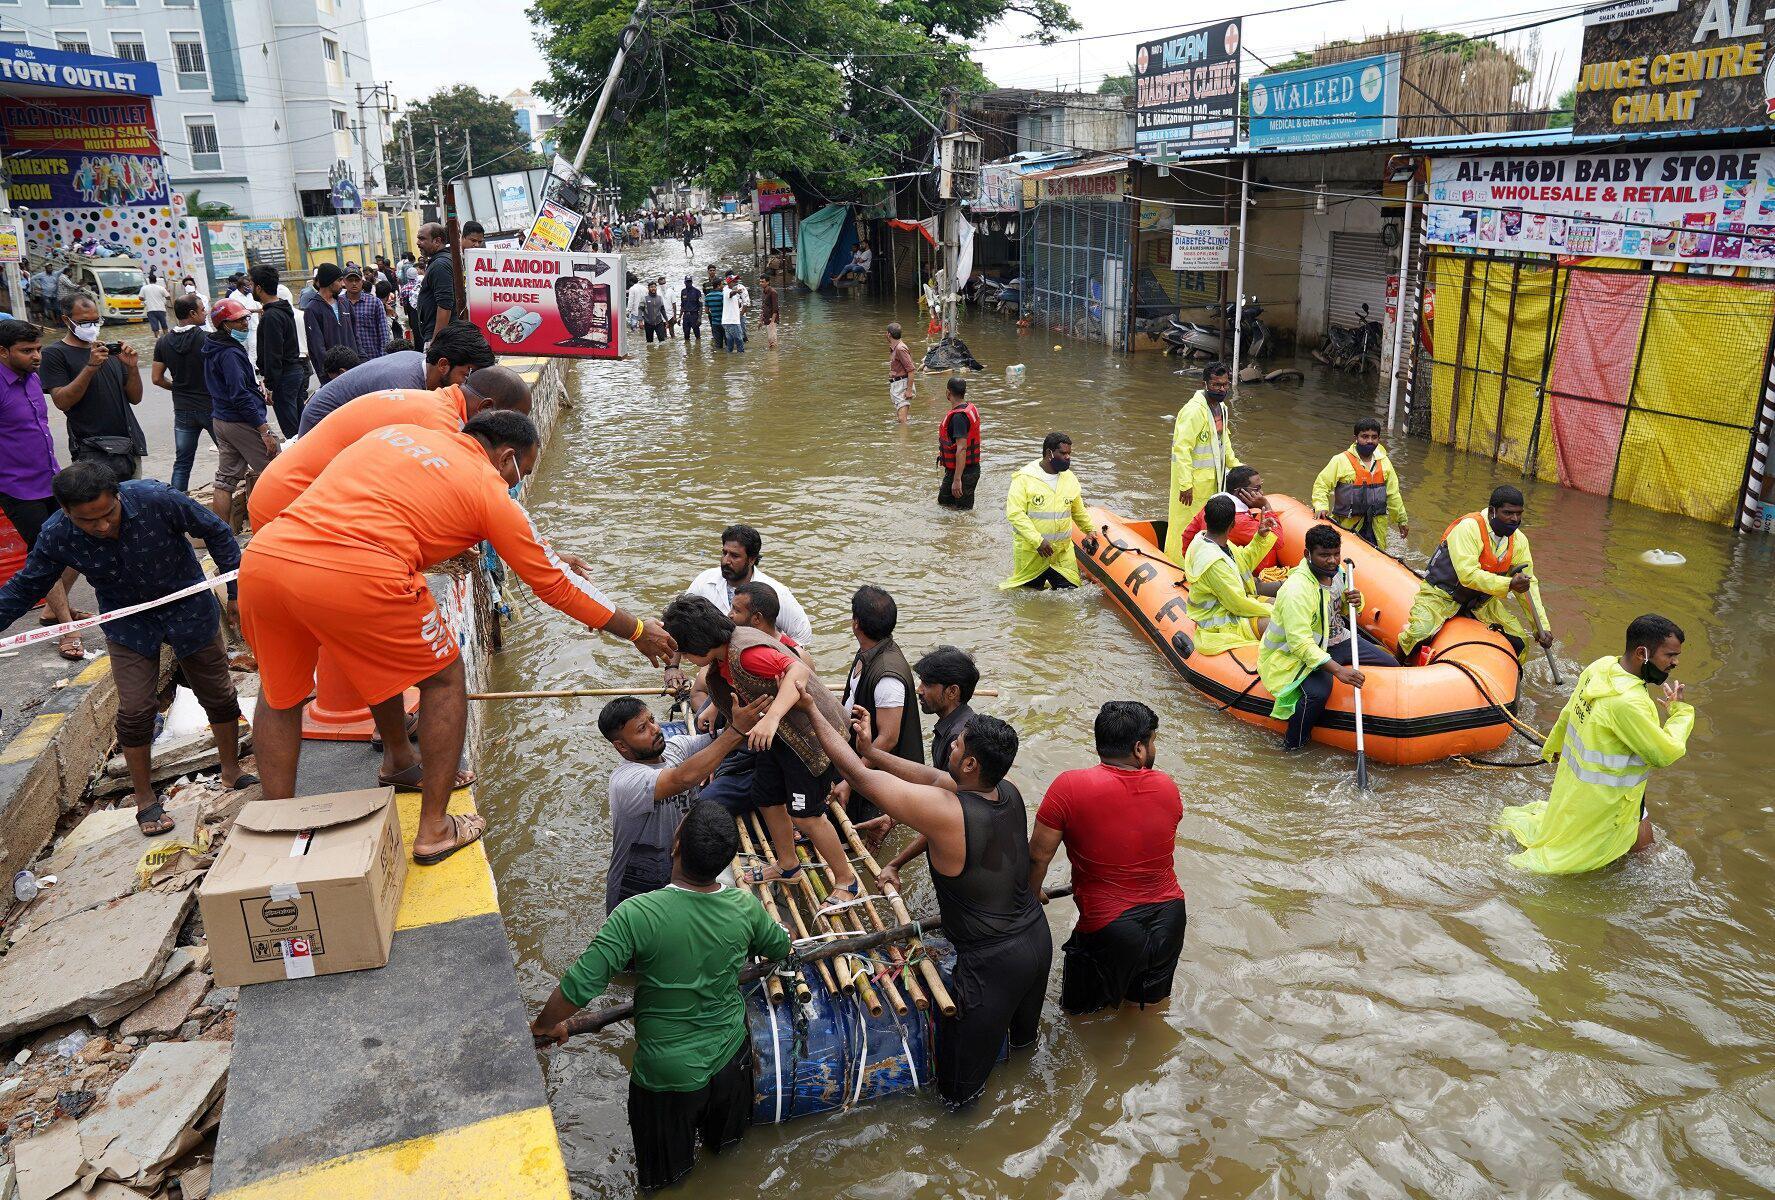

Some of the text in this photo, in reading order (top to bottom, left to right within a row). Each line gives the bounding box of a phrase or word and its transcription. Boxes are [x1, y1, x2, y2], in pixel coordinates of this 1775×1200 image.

[1599, 6, 1654, 22] SHAIK FAHAD AMODI
[1162, 31, 1209, 69] NIZAM
[1576, 41, 1767, 93] JUICE CENTRE
[62, 65, 137, 91] OUTLET
[1137, 59, 1237, 109] DIABETES CLINIC
[1272, 75, 1354, 112] WALEED
[5, 104, 147, 127] FACTORY OUTLET
[1612, 89, 1703, 125] CHAAT
[1269, 118, 1296, 131] MEDICAL
[1296, 118, 1302, 128] &
[1332, 111, 1357, 125] STORES
[53, 126, 115, 140] BRANDED
[84, 138, 150, 151] MULTI BRAND
[1456, 153, 1761, 183] AL-AMODI BABY STORE
[1067, 175, 1117, 195] TRADERS
[1490, 185, 1698, 203] WHOLESALE & RETAIL
[1175, 236, 1229, 246] DIABETES CLINIC
[474, 257, 561, 275] AL AMODI
[474, 276, 553, 290] SHAWARMA
[493, 292, 540, 304] HOUSE
[379, 427, 449, 468] NDRF
